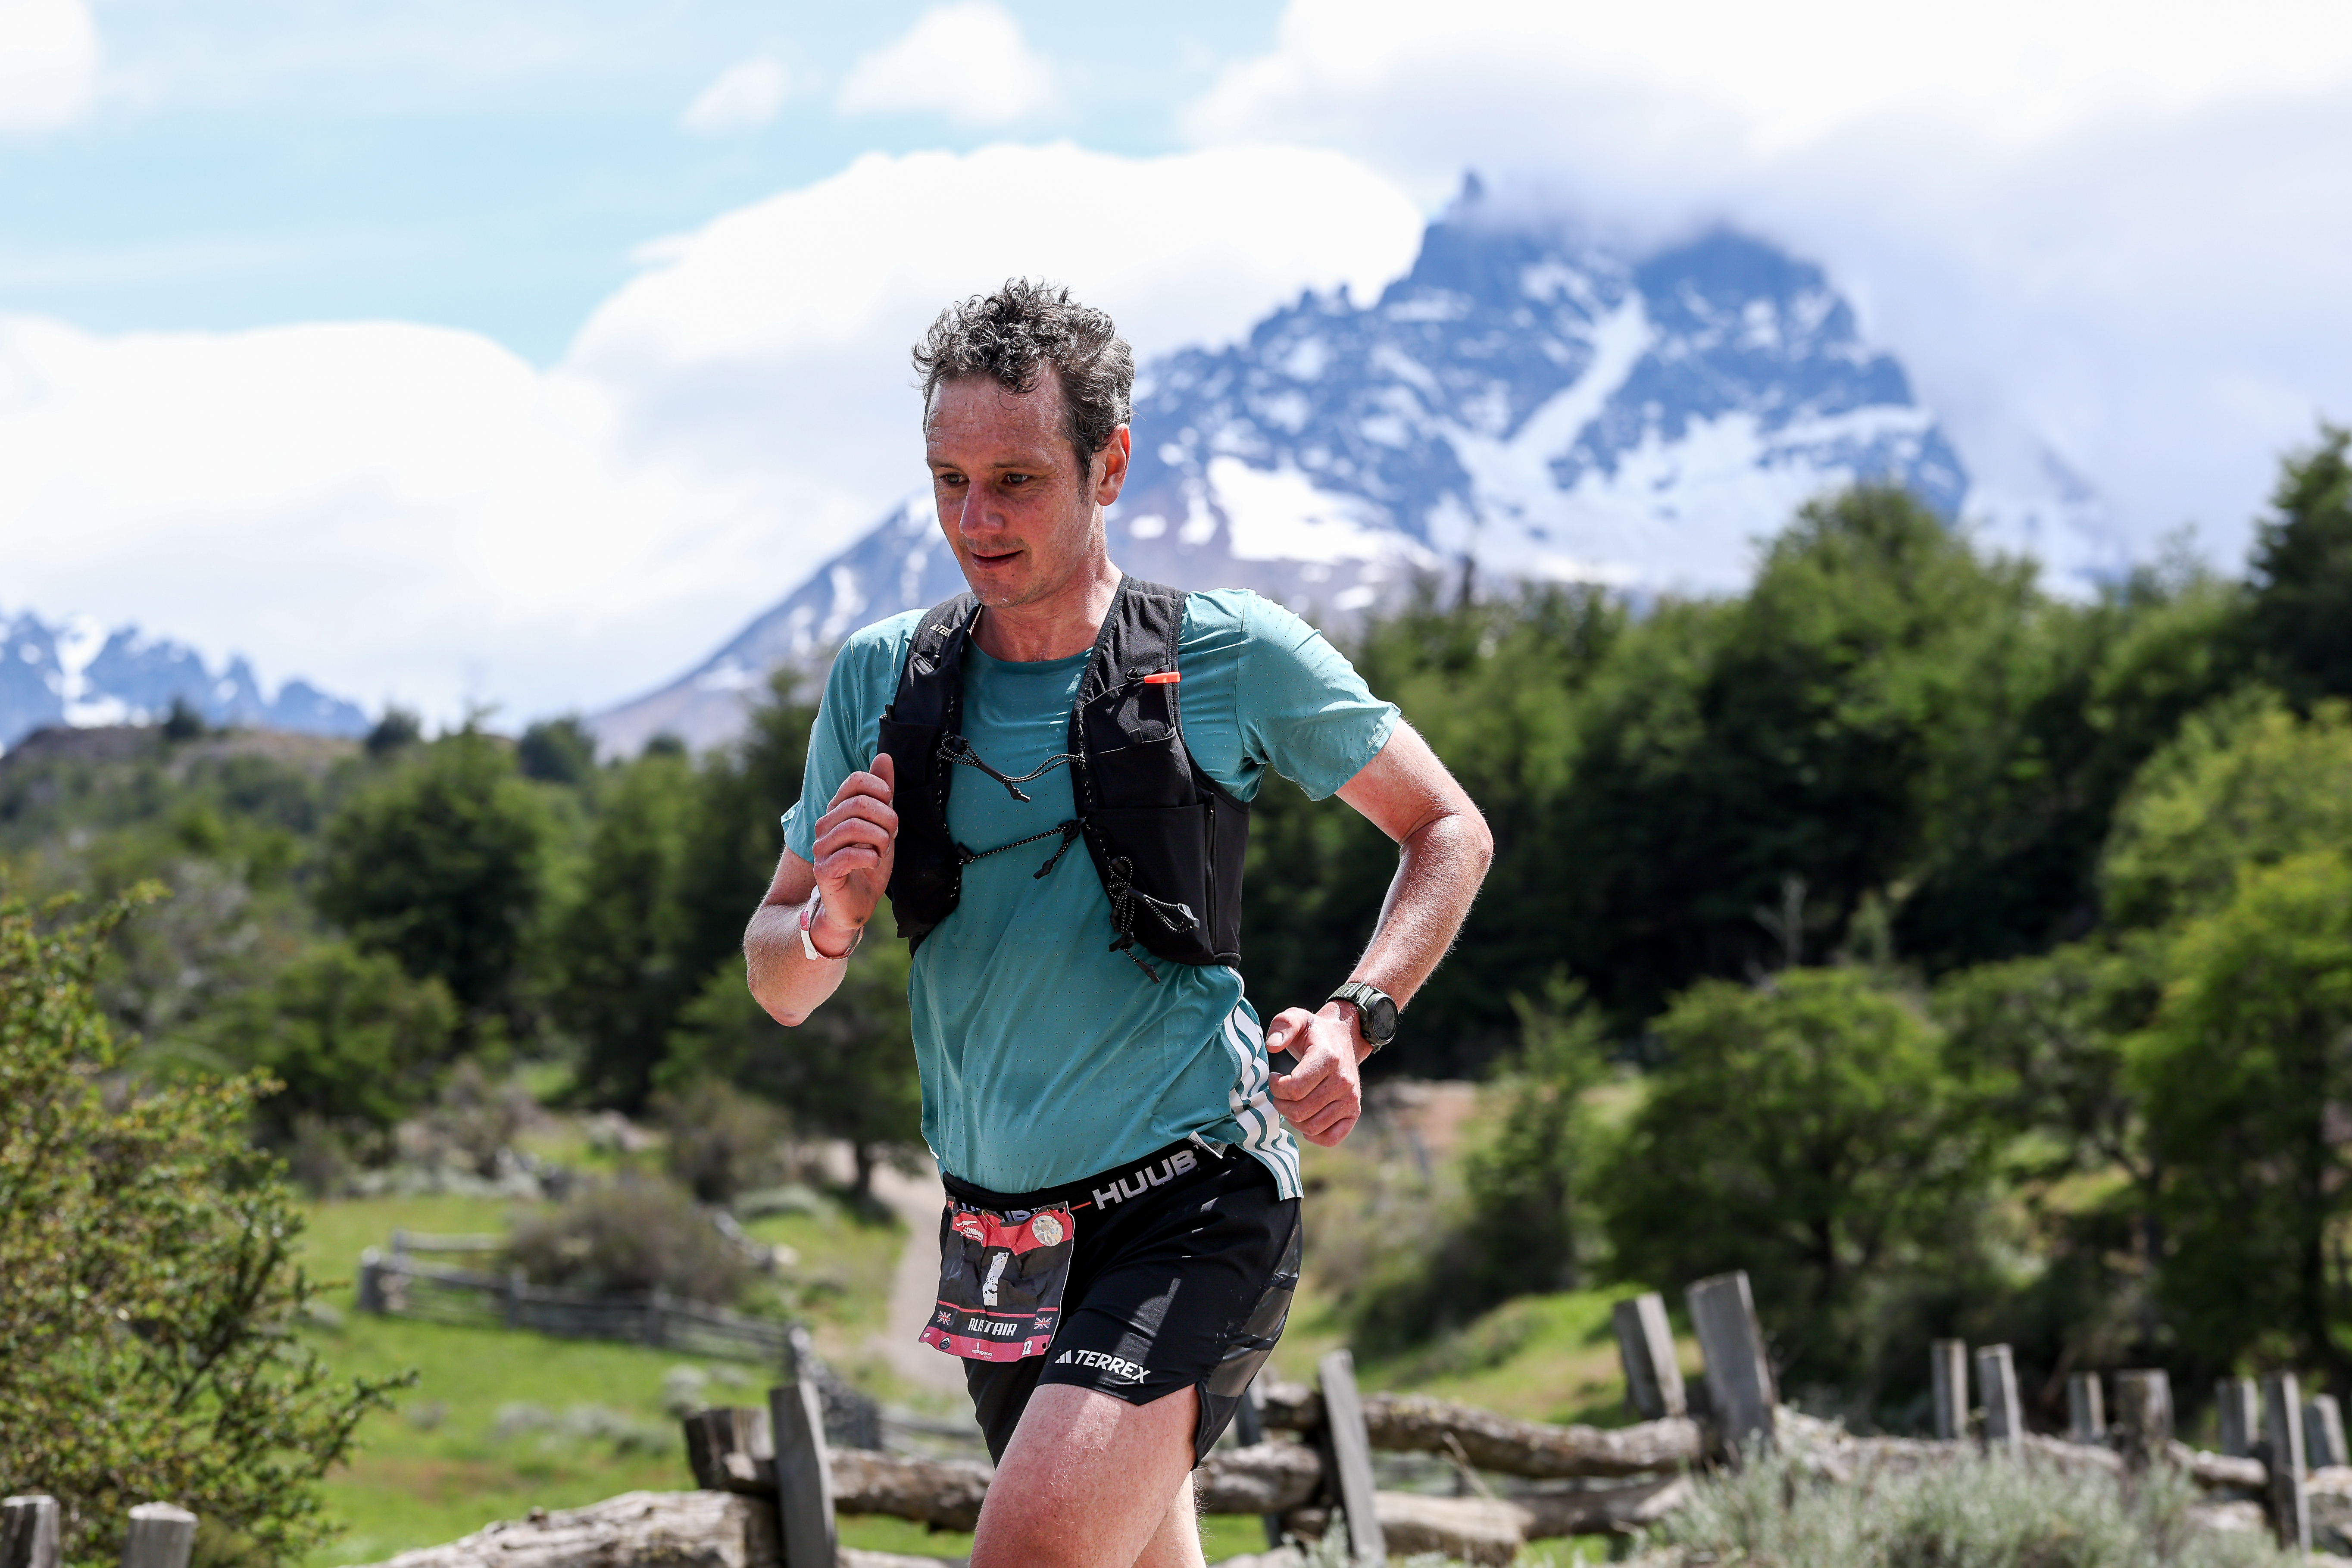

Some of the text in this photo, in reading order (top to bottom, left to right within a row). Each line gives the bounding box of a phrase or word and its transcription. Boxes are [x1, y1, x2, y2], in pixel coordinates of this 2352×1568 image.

[1092, 1150, 1197, 1210] HUUB
[982, 1252, 1009, 1306] 1
[968, 1318, 1018, 1336] ALISTAIR
[1074, 1349, 1151, 1384] TERREX
